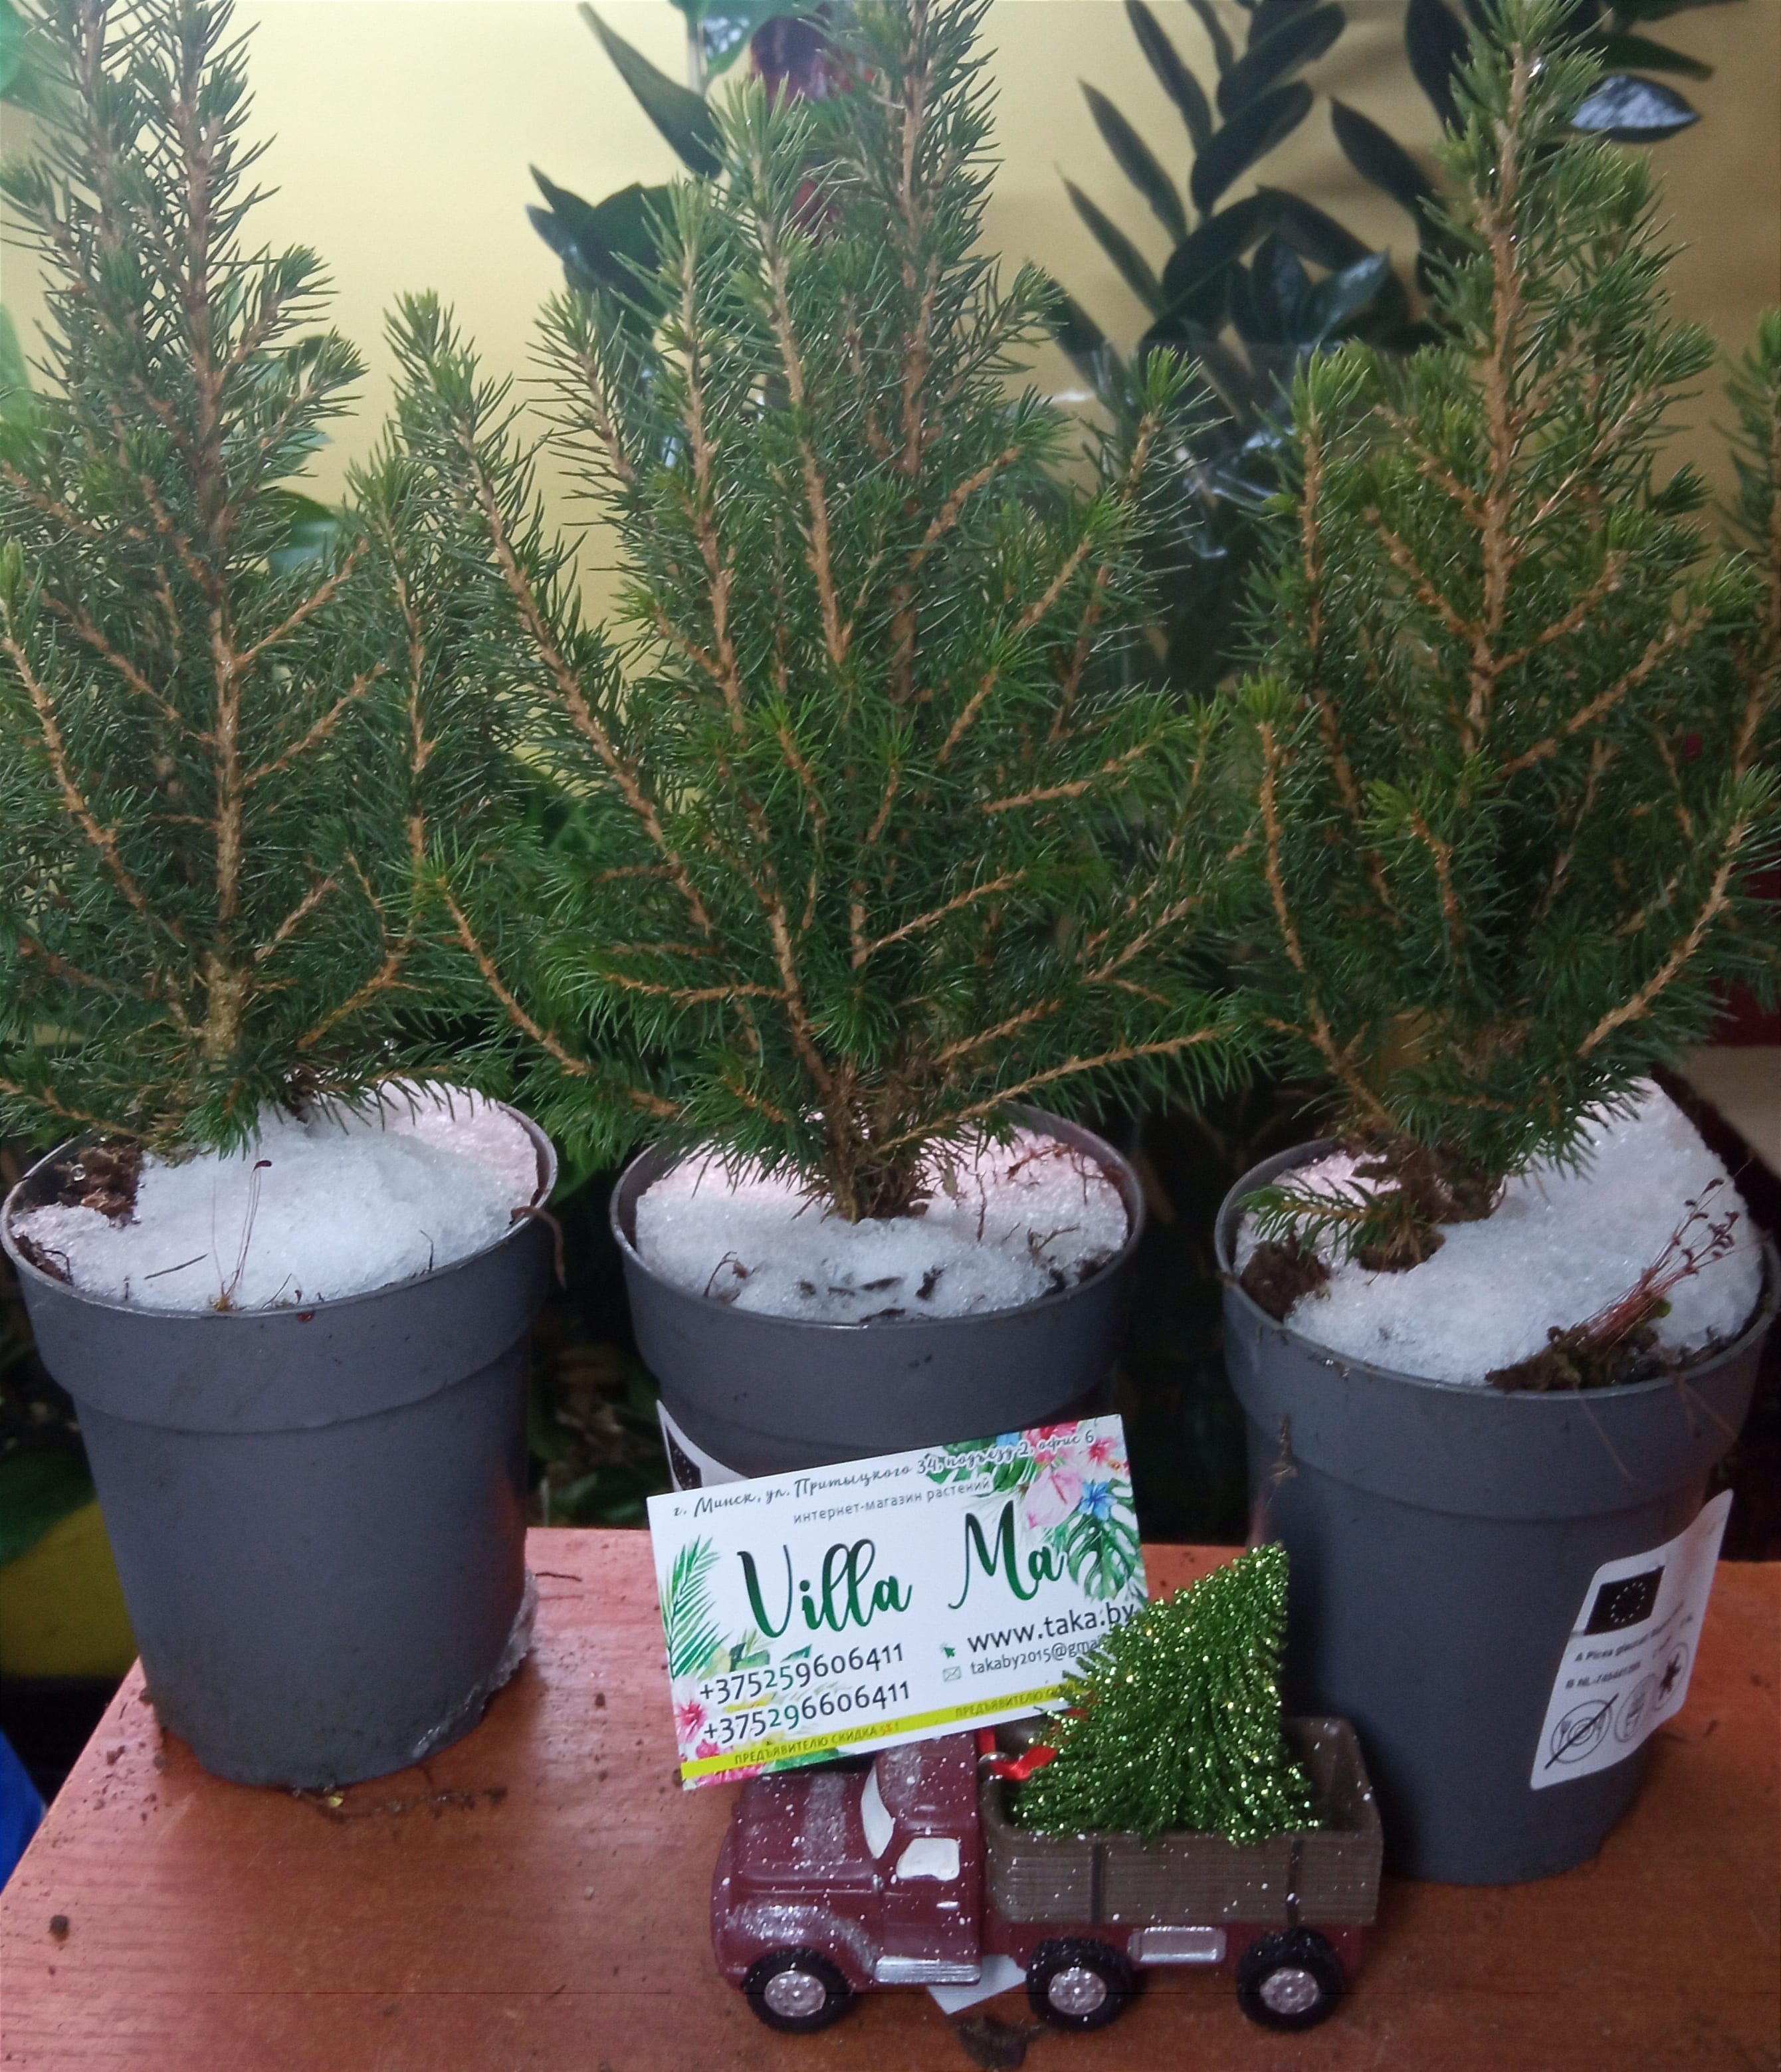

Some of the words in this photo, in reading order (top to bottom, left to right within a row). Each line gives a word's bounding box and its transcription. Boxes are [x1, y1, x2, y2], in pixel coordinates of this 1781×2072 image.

[694, 1493, 761, 1518] Минск,
[766, 1489, 790, 1504] ул.
[793, 1465, 912, 1498] Притыцкого
[1039, 1436, 1079, 1453] офис
[1085, 1430, 1095, 1443] 6
[793, 1491, 922, 1524] интернет-магазин
[928, 1477, 990, 1502] растений
[737, 1539, 912, 1638] Villa
[948, 1500, 1066, 1609] Ma
[967, 1602, 1134, 1652] www.taka.by
[700, 1643, 903, 1705] +375259606411
[971, 1636, 1102, 1675] takaby2015@gma
[704, 1681, 909, 1744] +375296606411
[956, 1691, 1043, 1716] ПРЕДЪЯВИТЕЛЮ
[735, 1737, 829, 1764] ПРЕДЪЯВИТЕЛЮ
[831, 1727, 877, 1744] СКИДКА
